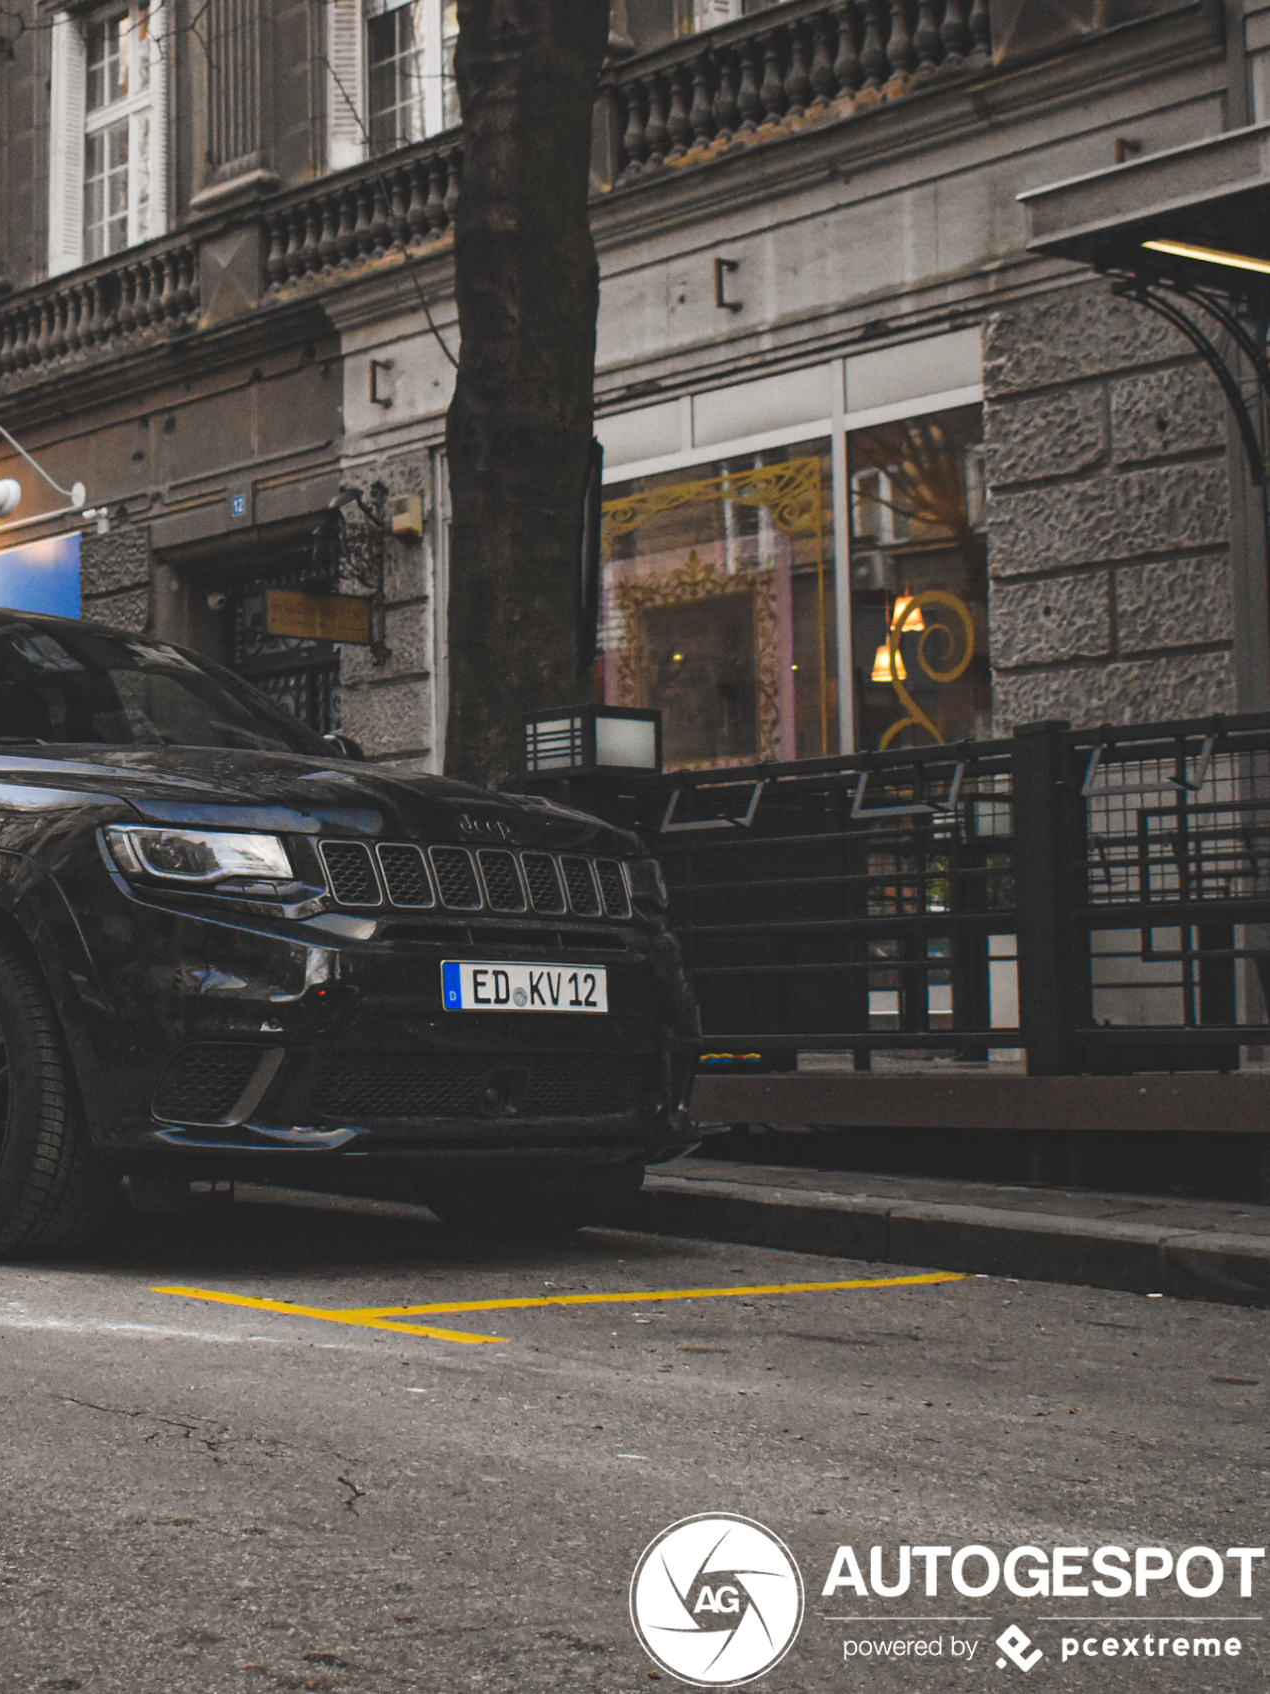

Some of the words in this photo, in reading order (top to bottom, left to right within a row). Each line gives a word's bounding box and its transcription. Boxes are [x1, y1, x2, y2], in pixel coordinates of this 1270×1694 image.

[449, 991, 457, 1001] D
[472, 969, 511, 1005] ED
[529, 970, 562, 1006] KV
[568, 972, 598, 1007] 12
